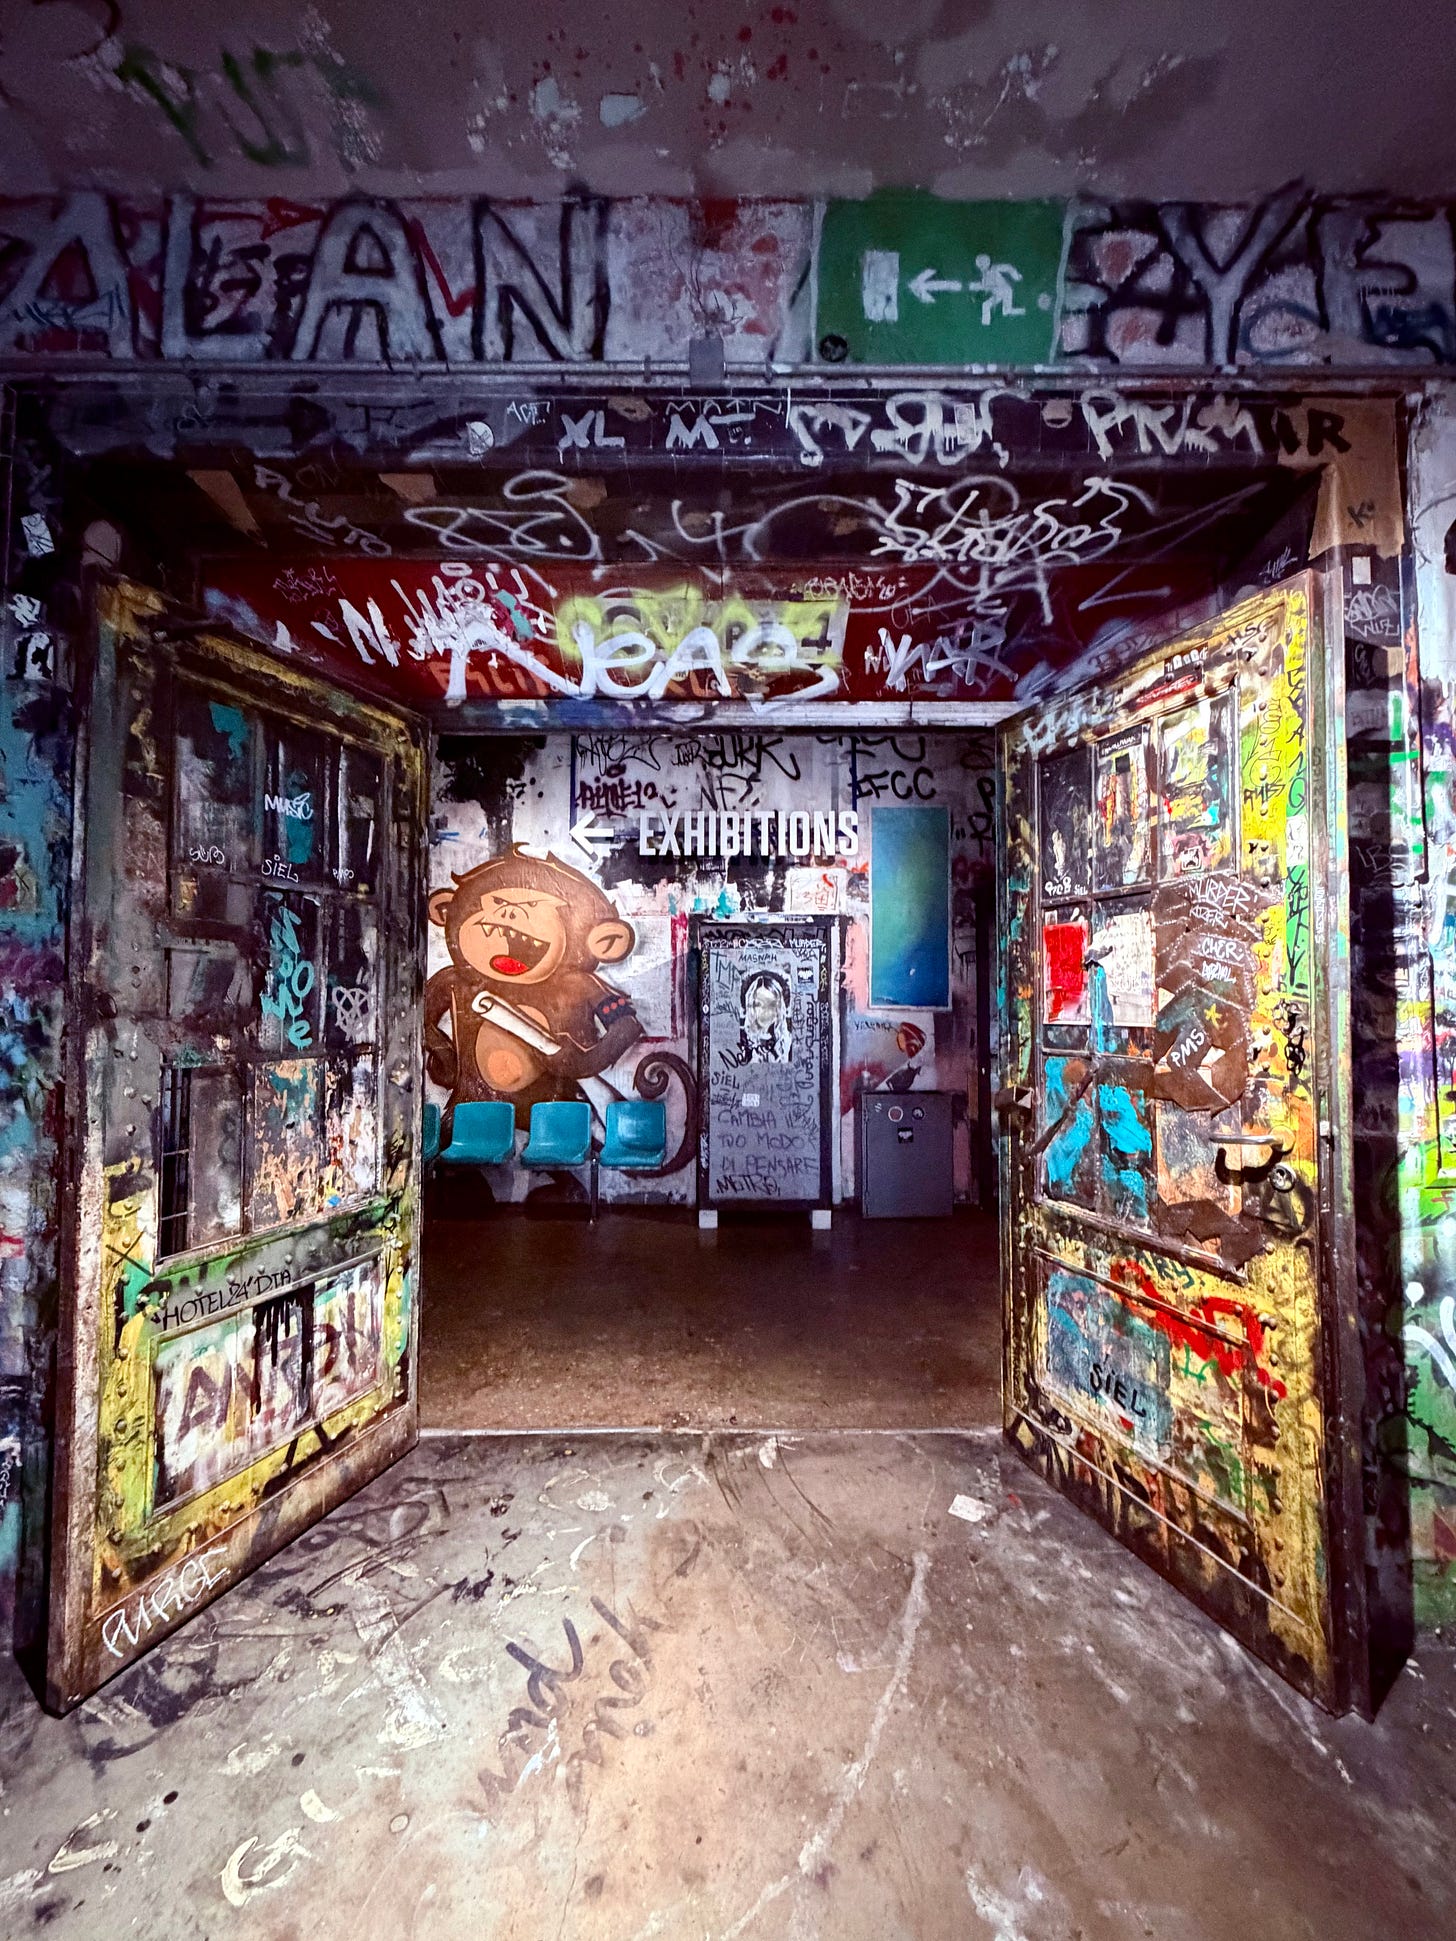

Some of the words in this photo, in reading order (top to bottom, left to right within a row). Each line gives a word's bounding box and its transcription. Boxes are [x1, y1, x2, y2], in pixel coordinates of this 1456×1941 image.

[558, 410, 626, 449] XL
[639, 810, 859, 857] EXHIBITIONS
[1170, 1028, 1205, 1068] PMS
